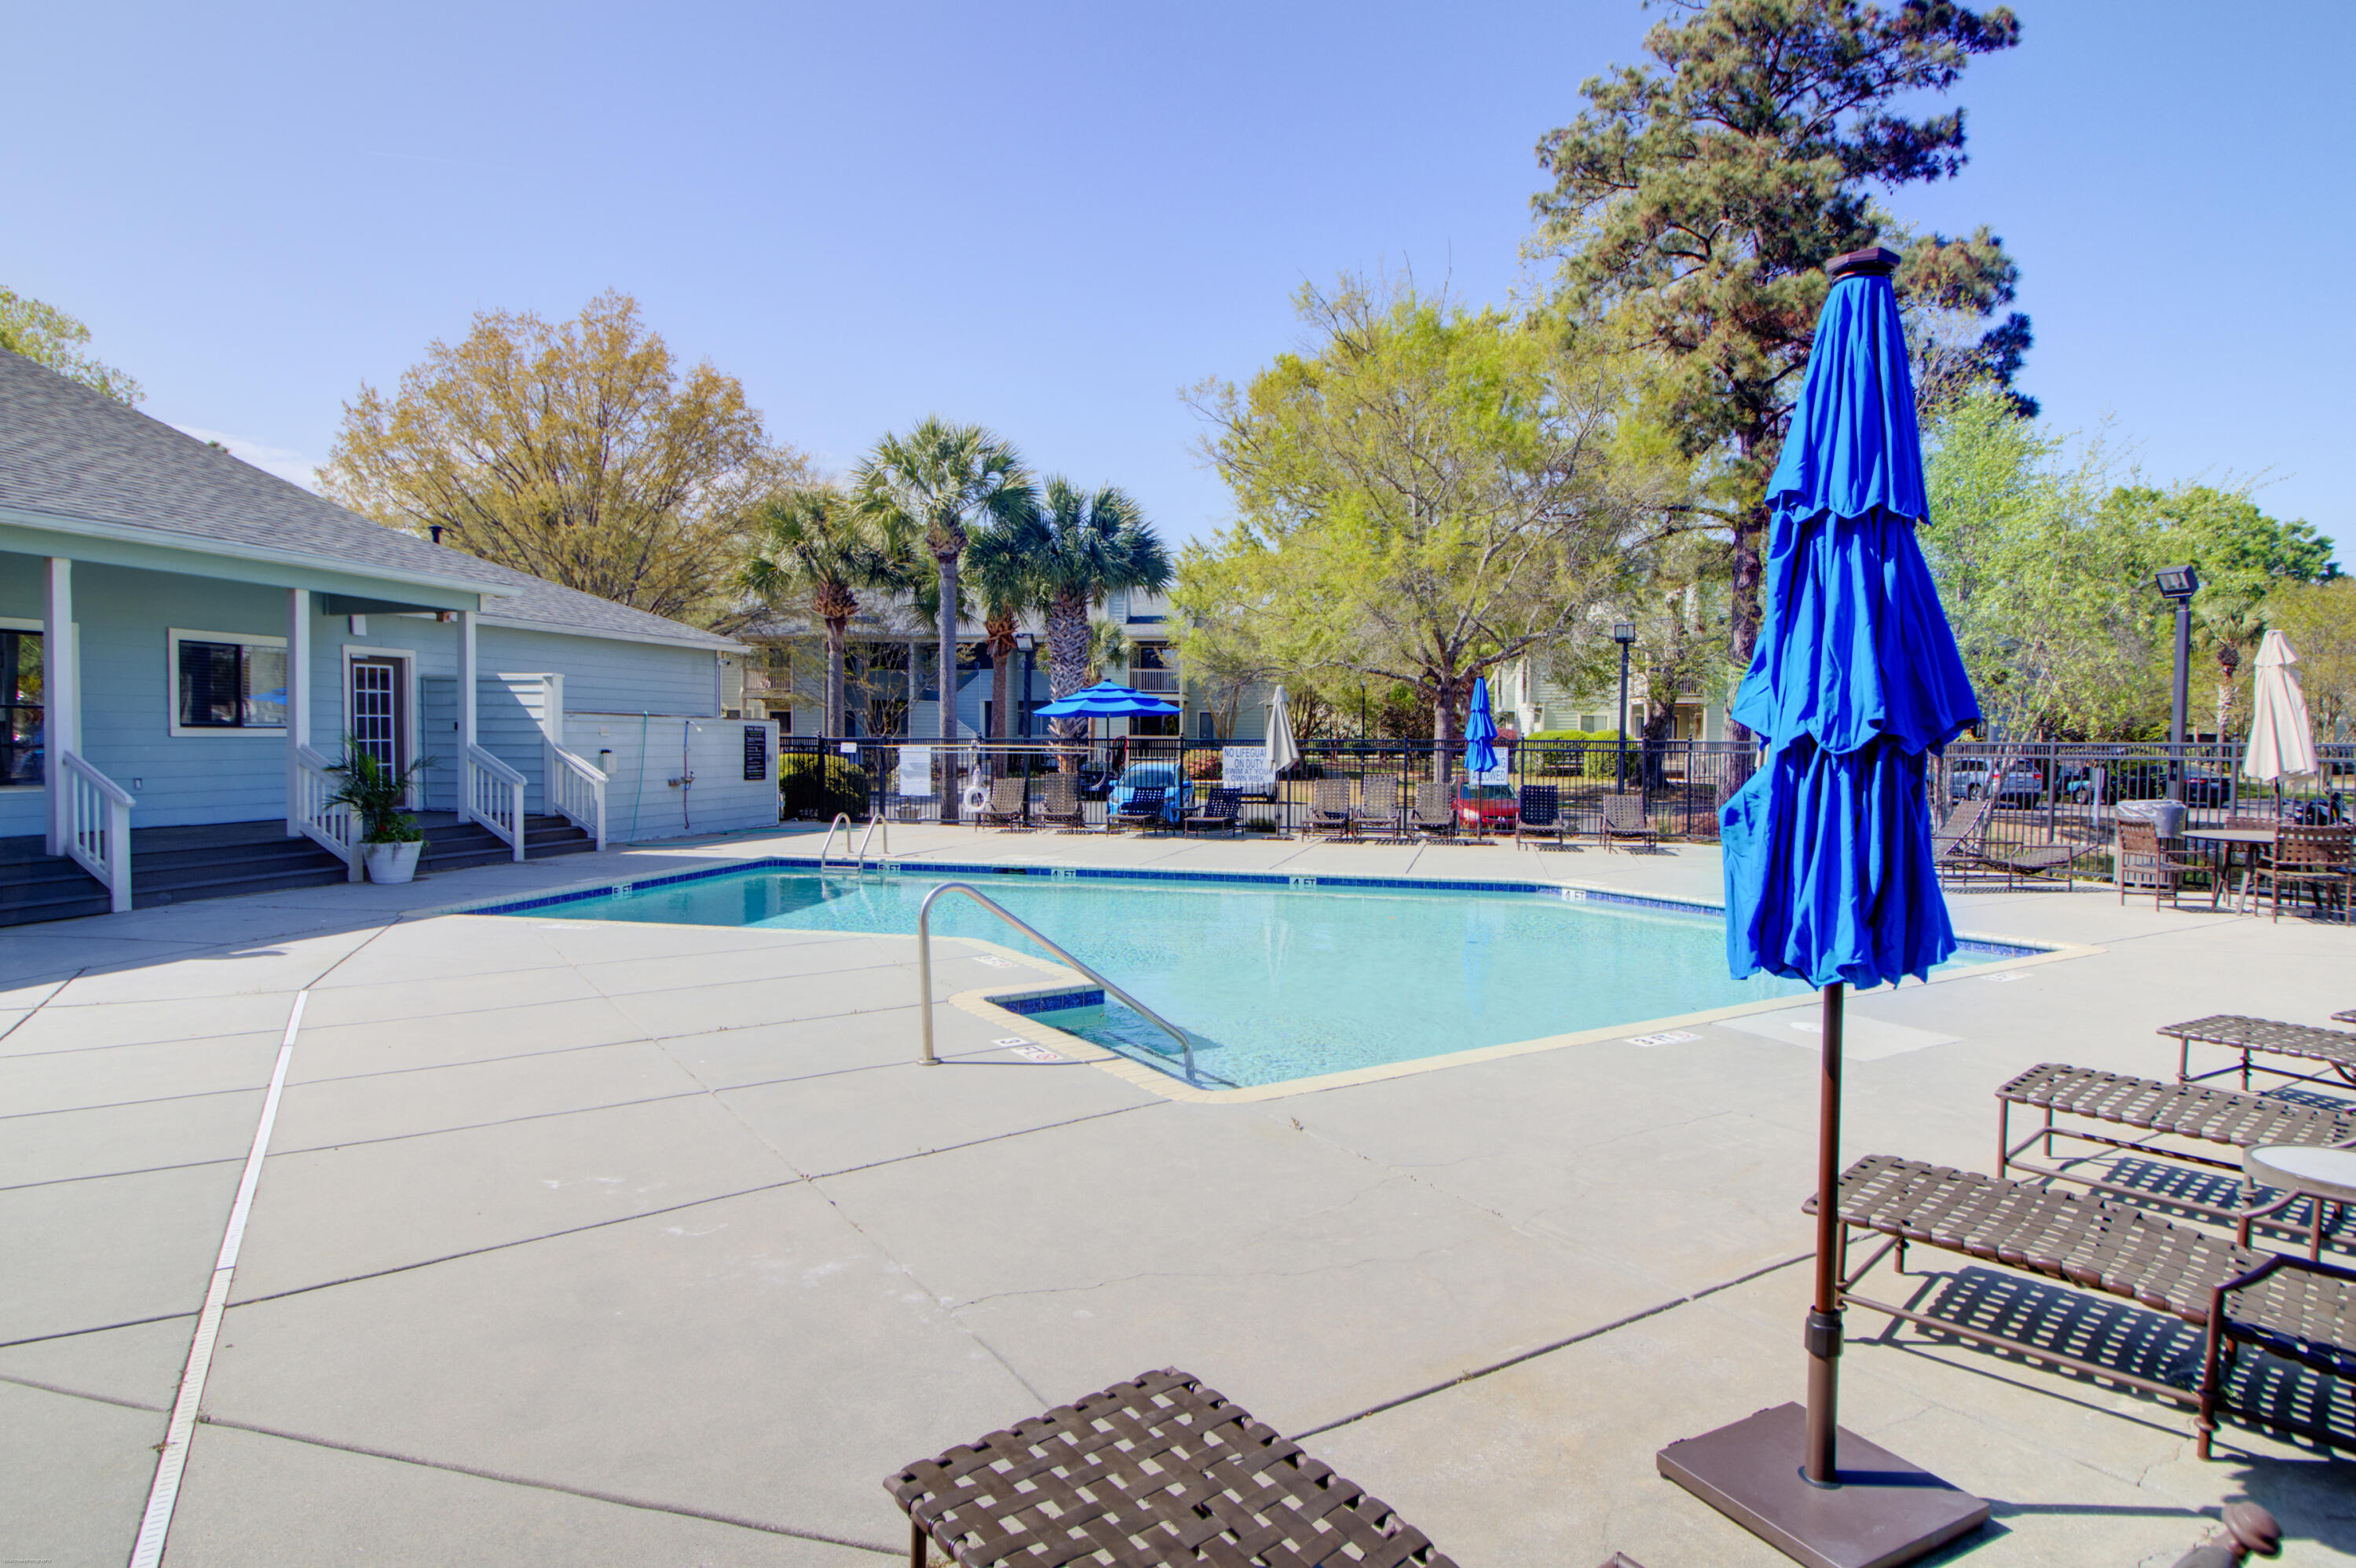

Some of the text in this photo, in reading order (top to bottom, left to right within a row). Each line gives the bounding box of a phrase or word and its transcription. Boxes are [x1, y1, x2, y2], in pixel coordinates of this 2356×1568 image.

[1225, 748, 1267, 757] NO LIFEGUA
[1235, 759, 1264, 768] ON DUTY
